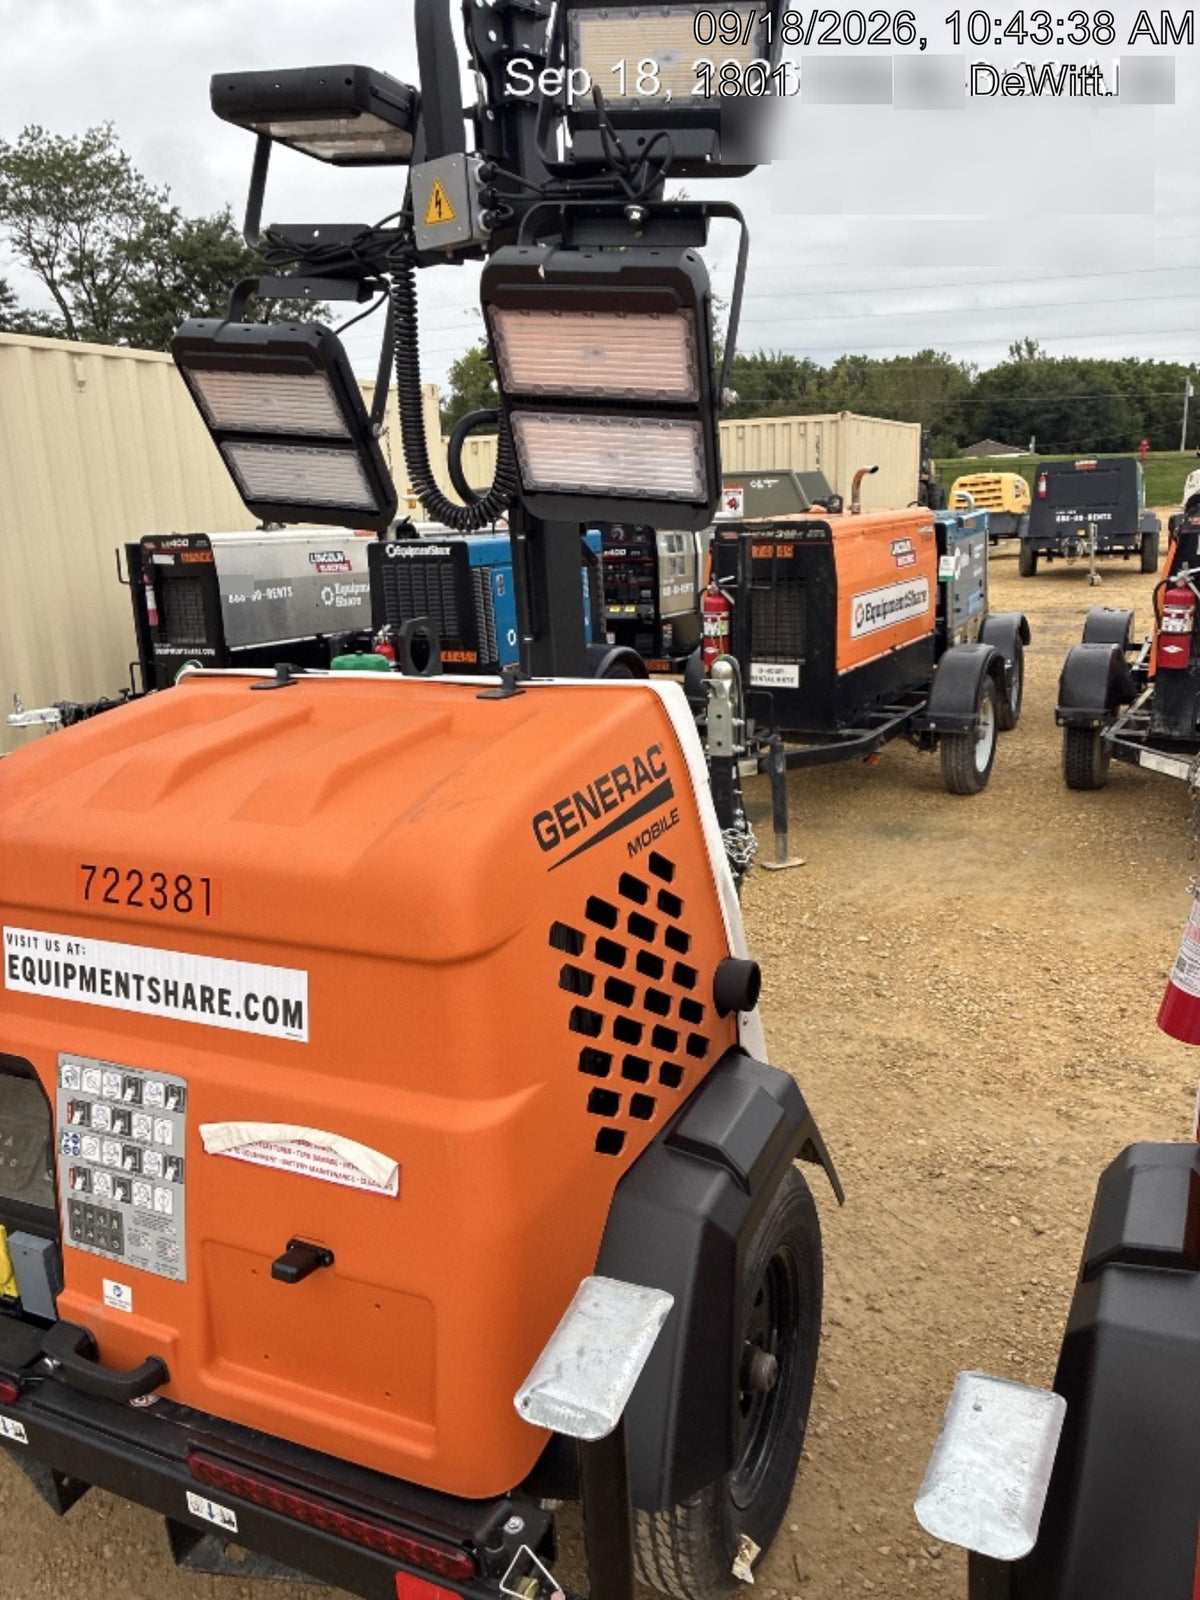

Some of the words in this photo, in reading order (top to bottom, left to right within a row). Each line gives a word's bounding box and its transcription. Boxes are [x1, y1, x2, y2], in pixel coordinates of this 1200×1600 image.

[532, 743, 668, 852] GENERAC
[627, 807, 680, 858] MOBILE
[81, 864, 210, 916] 722381
[6, 933, 39, 949] VISIT
[45, 938, 61, 952] US
[66, 942, 86, 955] AT:
[8, 954, 303, 1030] EQUIPMENTSHARE.COM
